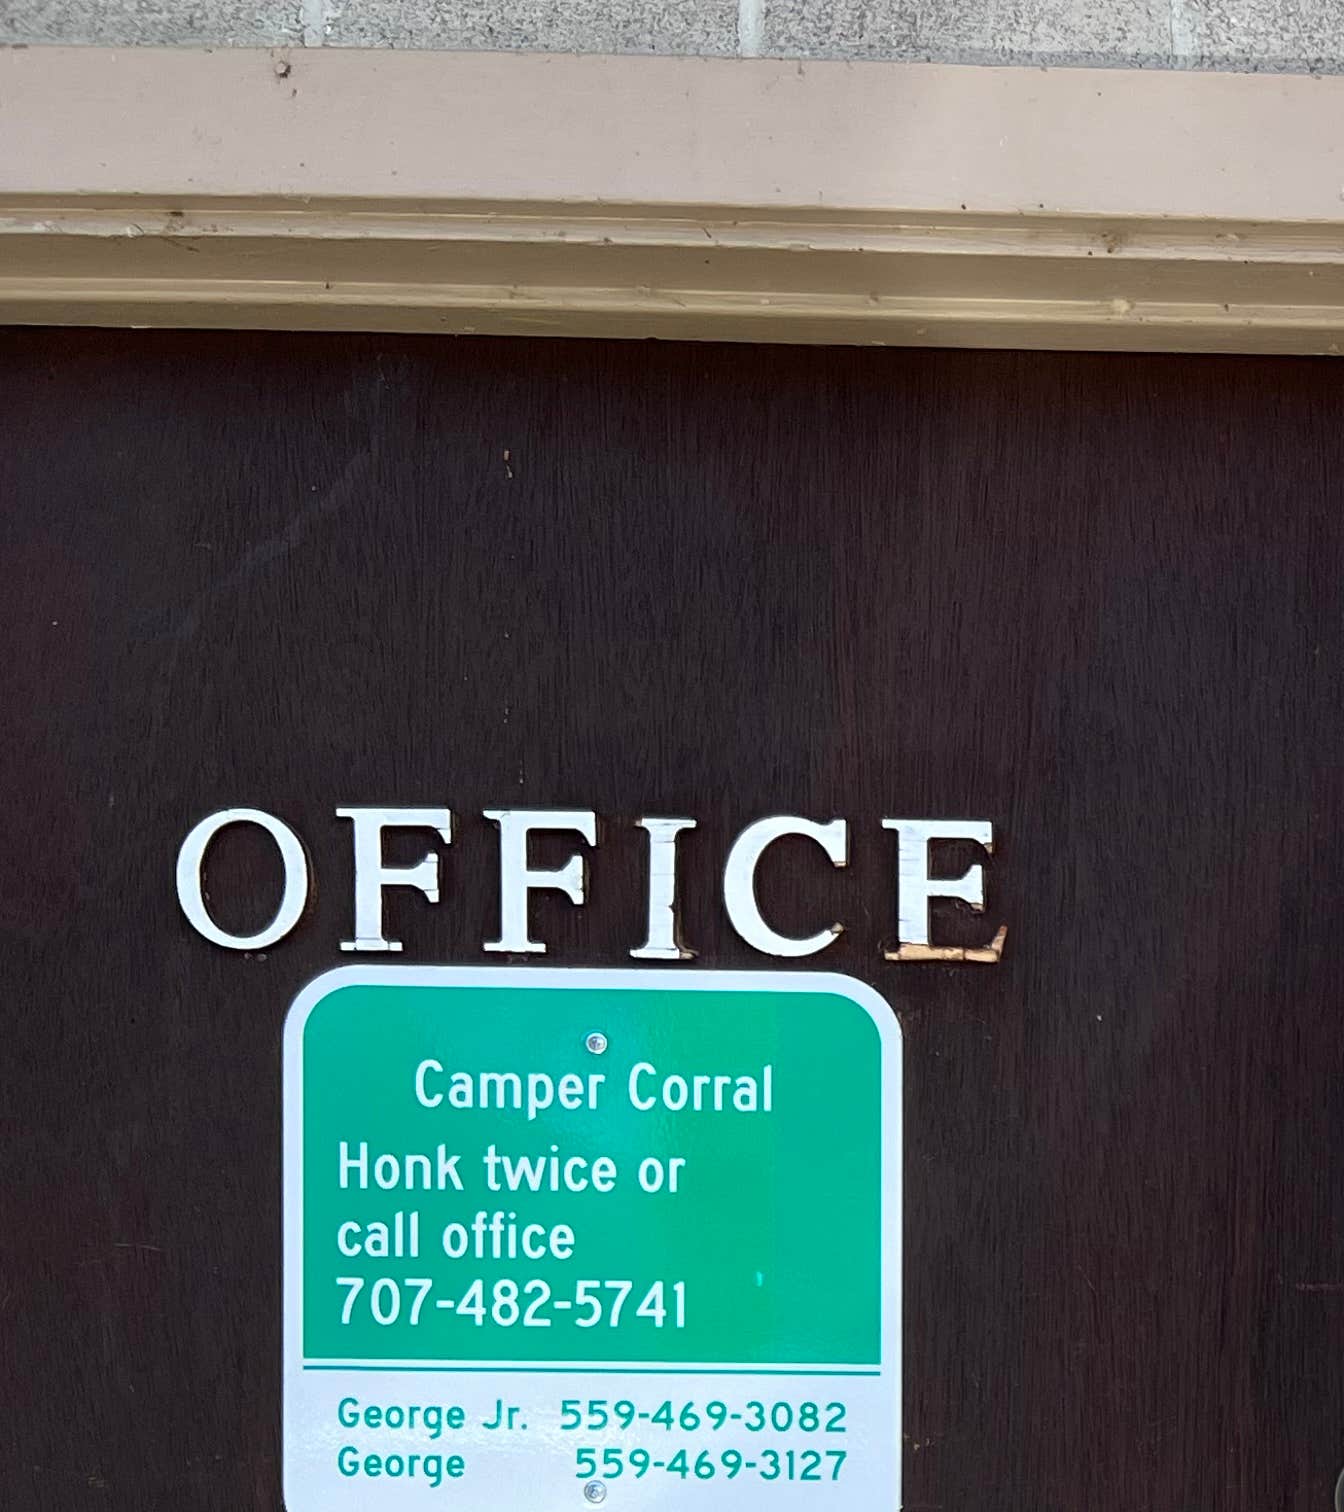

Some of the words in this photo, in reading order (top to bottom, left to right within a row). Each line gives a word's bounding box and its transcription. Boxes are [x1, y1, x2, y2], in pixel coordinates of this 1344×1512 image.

[176, 807, 1008, 963] OFFICE
[414, 1060, 603, 1120] Camper
[629, 1063, 771, 1111] Corral
[338, 1142, 464, 1191] Honk
[484, 1145, 616, 1191] twice
[639, 1158, 685, 1192] or
[338, 1212, 420, 1258] call
[443, 1212, 574, 1258] office
[337, 1278, 684, 1326] 707-482-5741
[337, 1396, 468, 1438] George
[481, 1397, 528, 1431] Jr.
[560, 1398, 848, 1434] 559-469-3082
[337, 1446, 467, 1487] George
[576, 1449, 848, 1482] 559-469-3127
